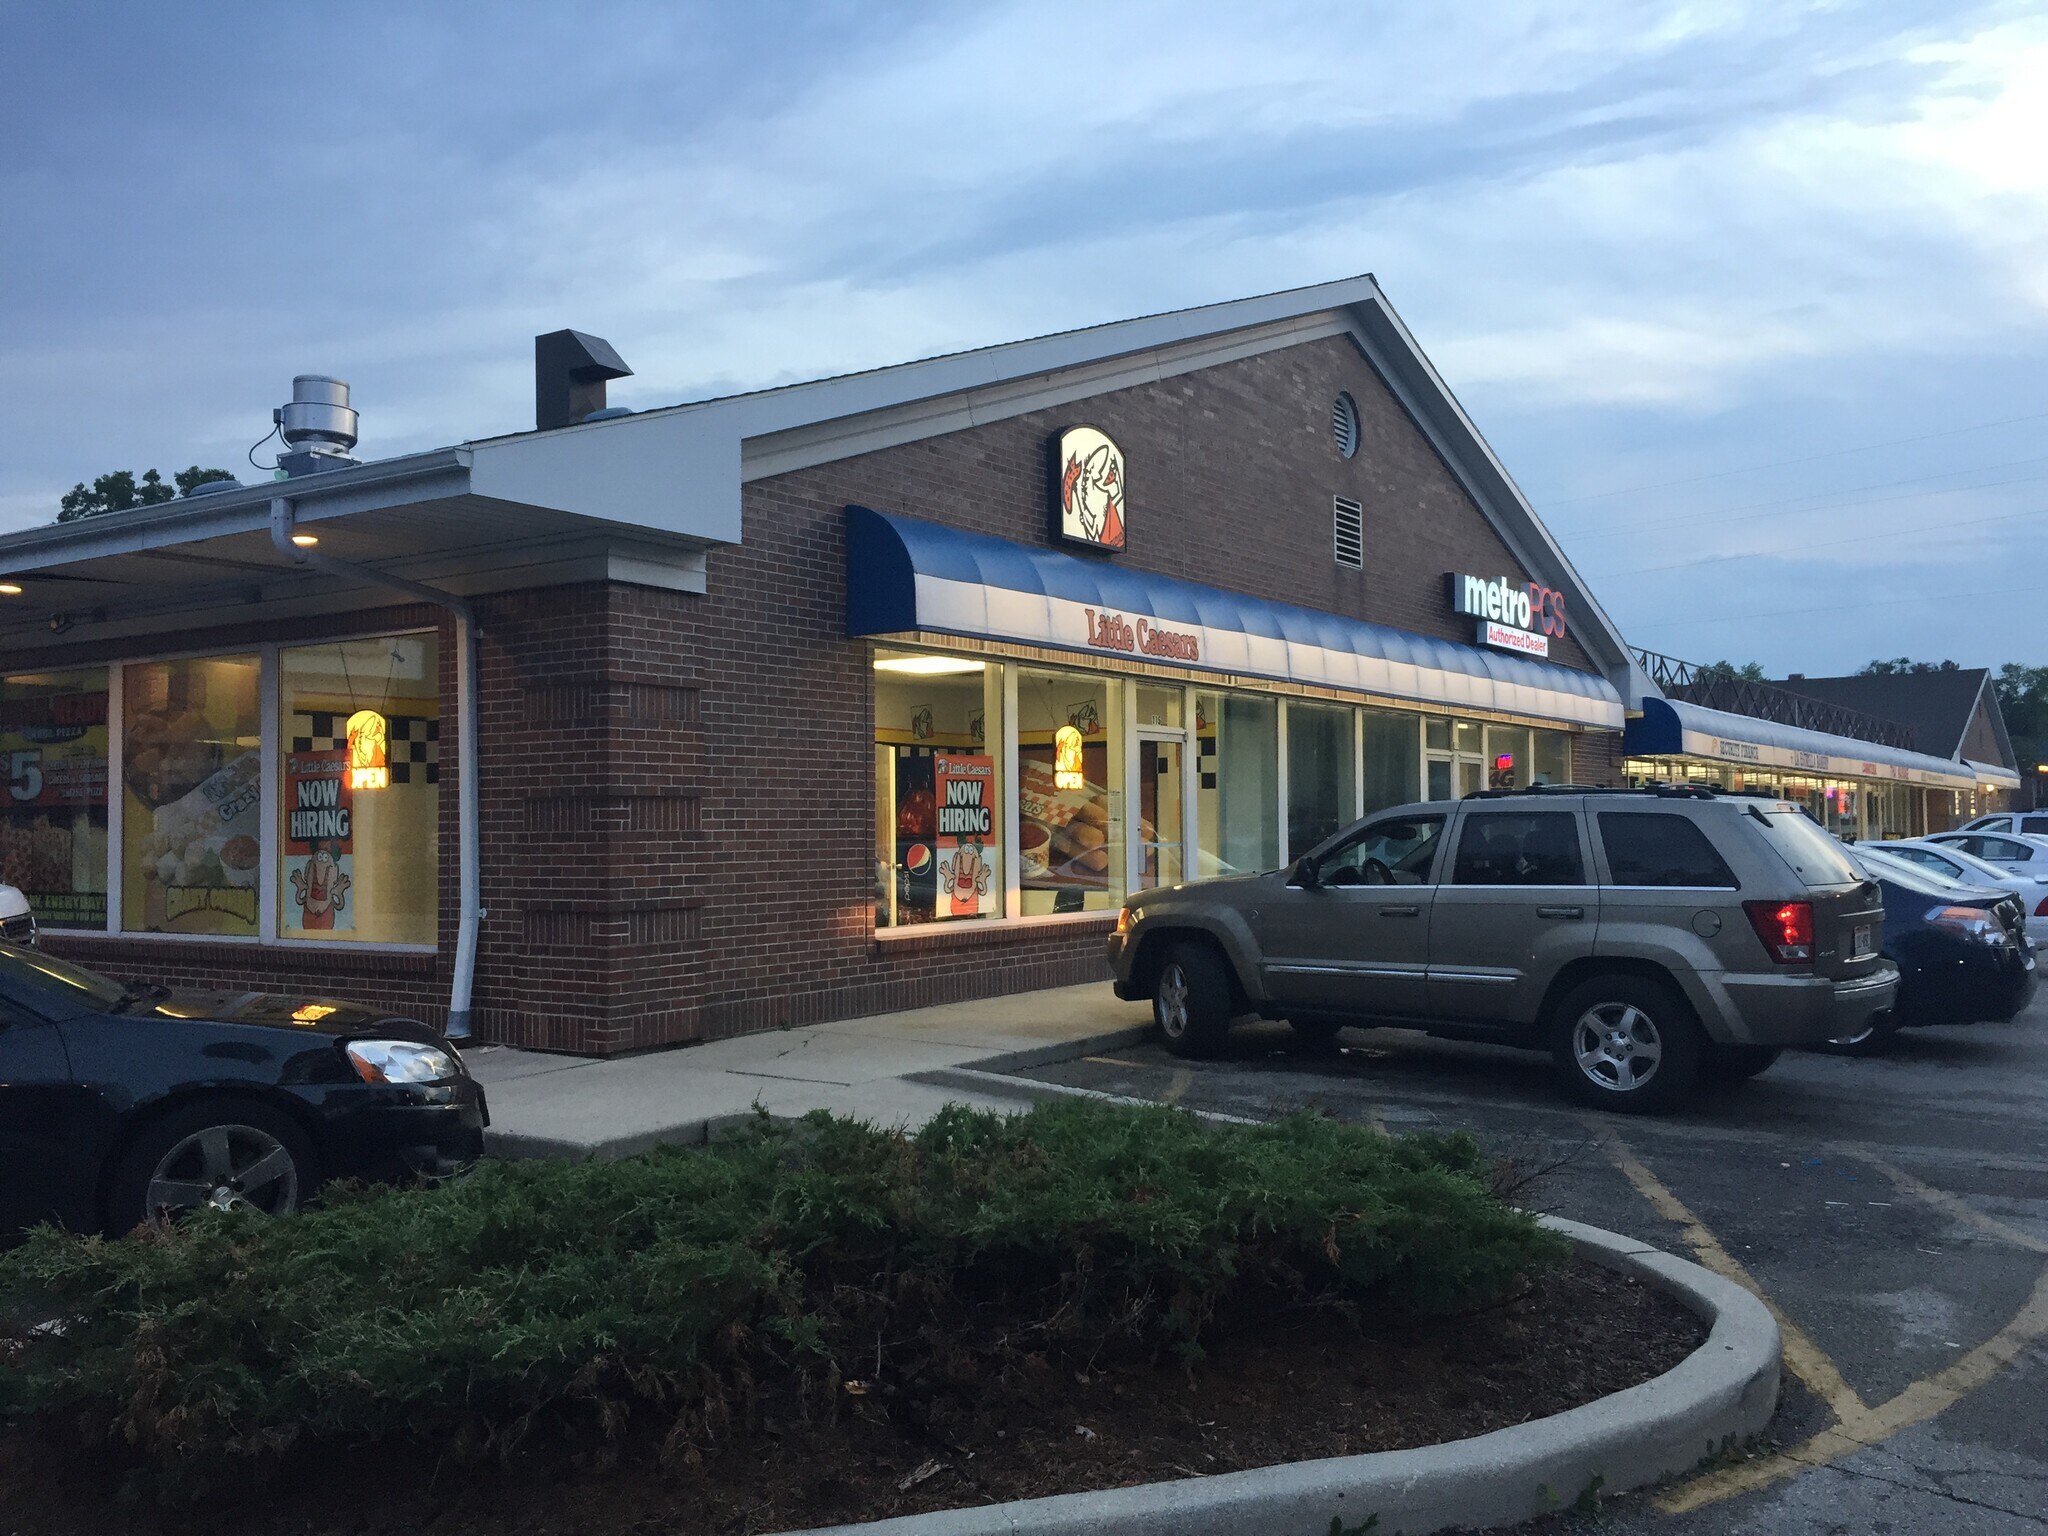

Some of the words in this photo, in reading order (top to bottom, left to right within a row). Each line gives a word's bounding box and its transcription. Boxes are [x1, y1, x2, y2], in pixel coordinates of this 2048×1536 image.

[1464, 575, 1565, 639] metroPCS
[1085, 608, 1134, 652] Little
[1137, 618, 1199, 661] Caesars
[1489, 626, 1525, 648] Authorized
[1526, 635, 1546, 652] Dealer
[301, 761, 320, 774] Little
[321, 759, 352, 772] Caesars
[948, 763, 966, 775] Little
[967, 764, 992, 776] Caesars
[297, 780, 339, 808] NOW
[946, 781, 982, 806] NOW
[291, 809, 349, 838] HIRING
[939, 808, 990, 833] HIRING
[903, 871, 911, 901] pepsi
